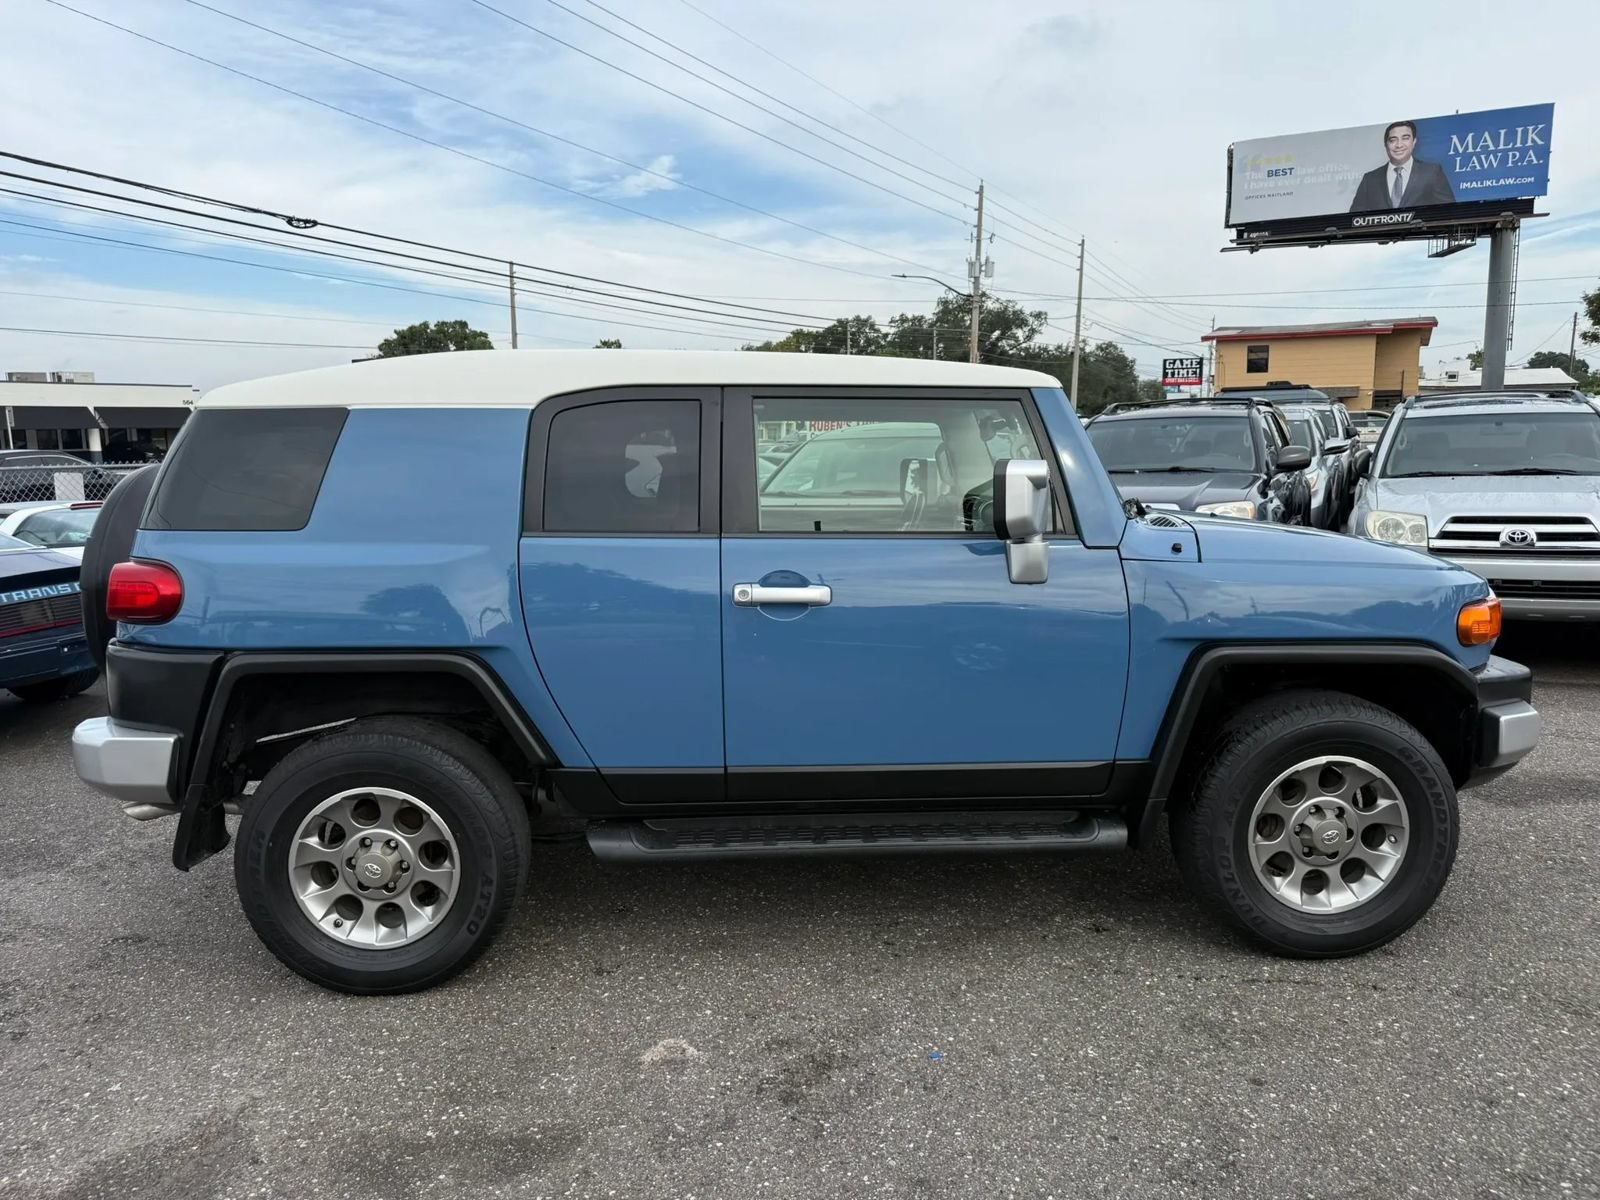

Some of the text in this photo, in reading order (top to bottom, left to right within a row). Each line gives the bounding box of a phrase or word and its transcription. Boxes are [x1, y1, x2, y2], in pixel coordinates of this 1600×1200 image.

[1448, 124, 1545, 155] MALIK
[1455, 149, 1544, 172] LAW P.A.
[1266, 167, 1295, 179] BEST
[1245, 193, 1266, 201] OFFICES
[1165, 359, 1200, 369] GAME
[1165, 368, 1200, 378] TIME!
[0, 583, 72, 603] TRANS
[466, 869, 495, 937] AT20
